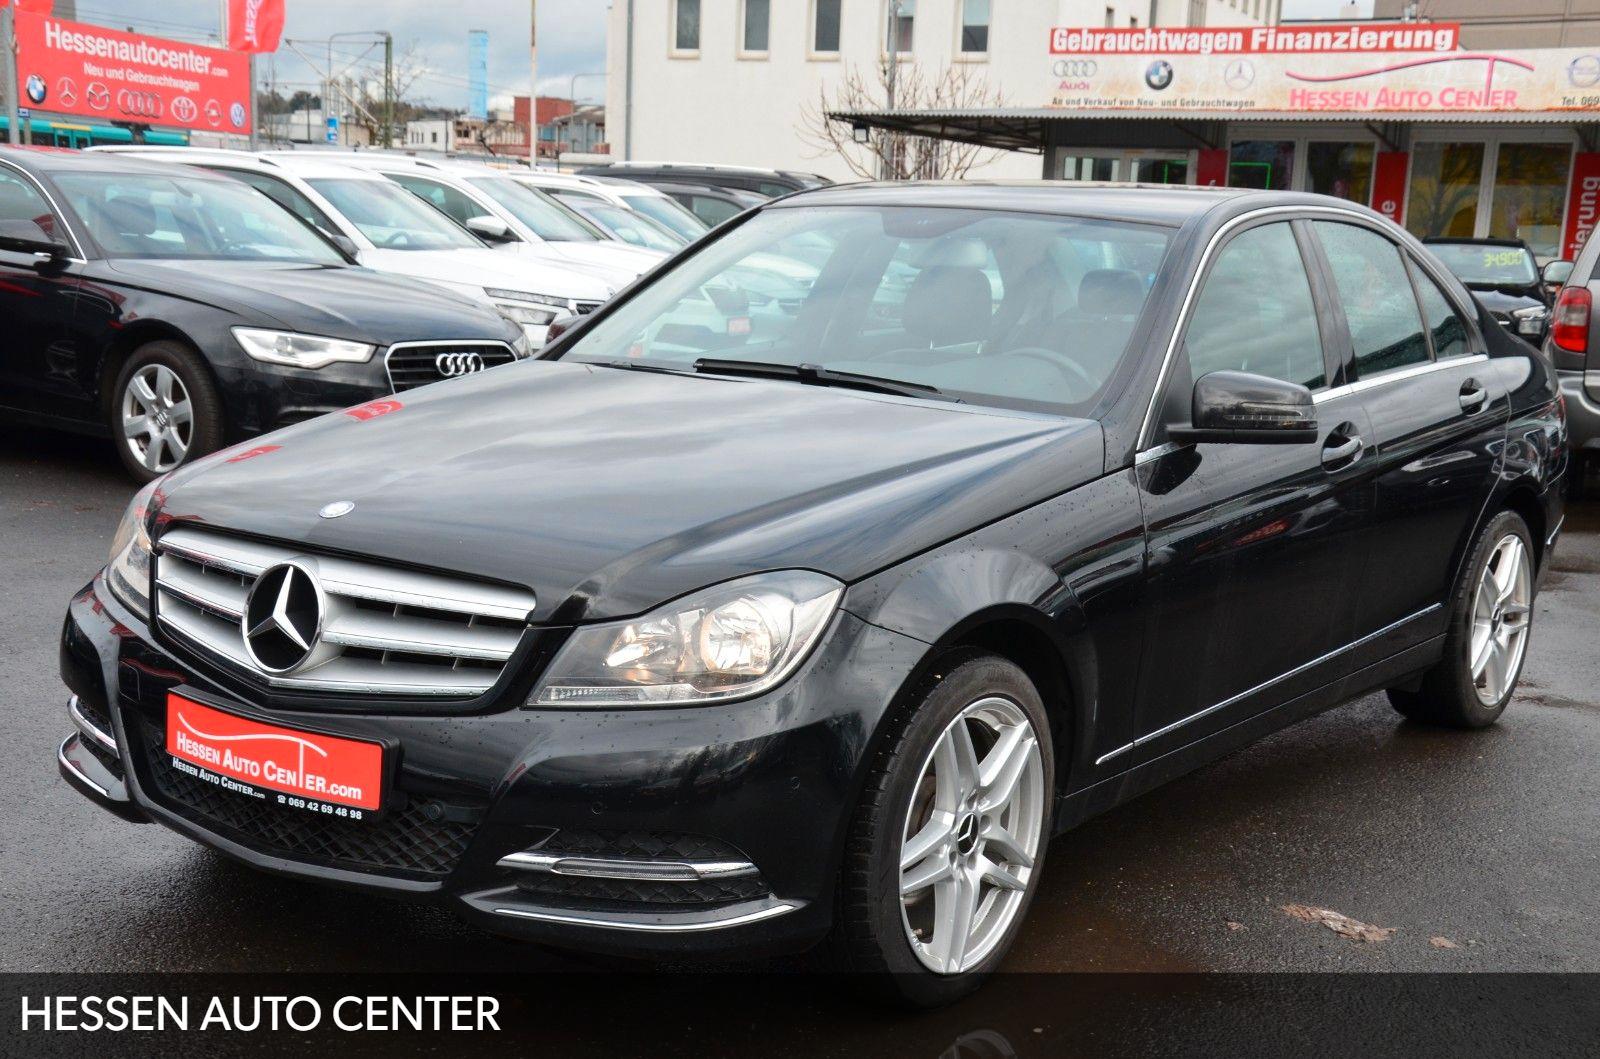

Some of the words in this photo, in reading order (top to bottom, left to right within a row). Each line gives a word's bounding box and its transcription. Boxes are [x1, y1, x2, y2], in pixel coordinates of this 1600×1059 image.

[1053, 28, 1243, 54] Gebrauchtwagen
[1251, 26, 1455, 51] Finanzierung
[83, 62, 104, 77] Neu
[105, 68, 125, 80] und
[126, 69, 200, 93] Gebrauchtwagen
[1180, 99, 1256, 109] Gebrauchtwagen
[176, 731, 221, 765] HESSEN
[222, 748, 261, 777] AUTO
[199, 769, 220, 785] AUTO
[288, 797, 305, 808] 069
[307, 802, 319, 811] 42
[321, 804, 333, 814] 69
[335, 807, 347, 817] 48
[350, 809, 362, 820] 98
